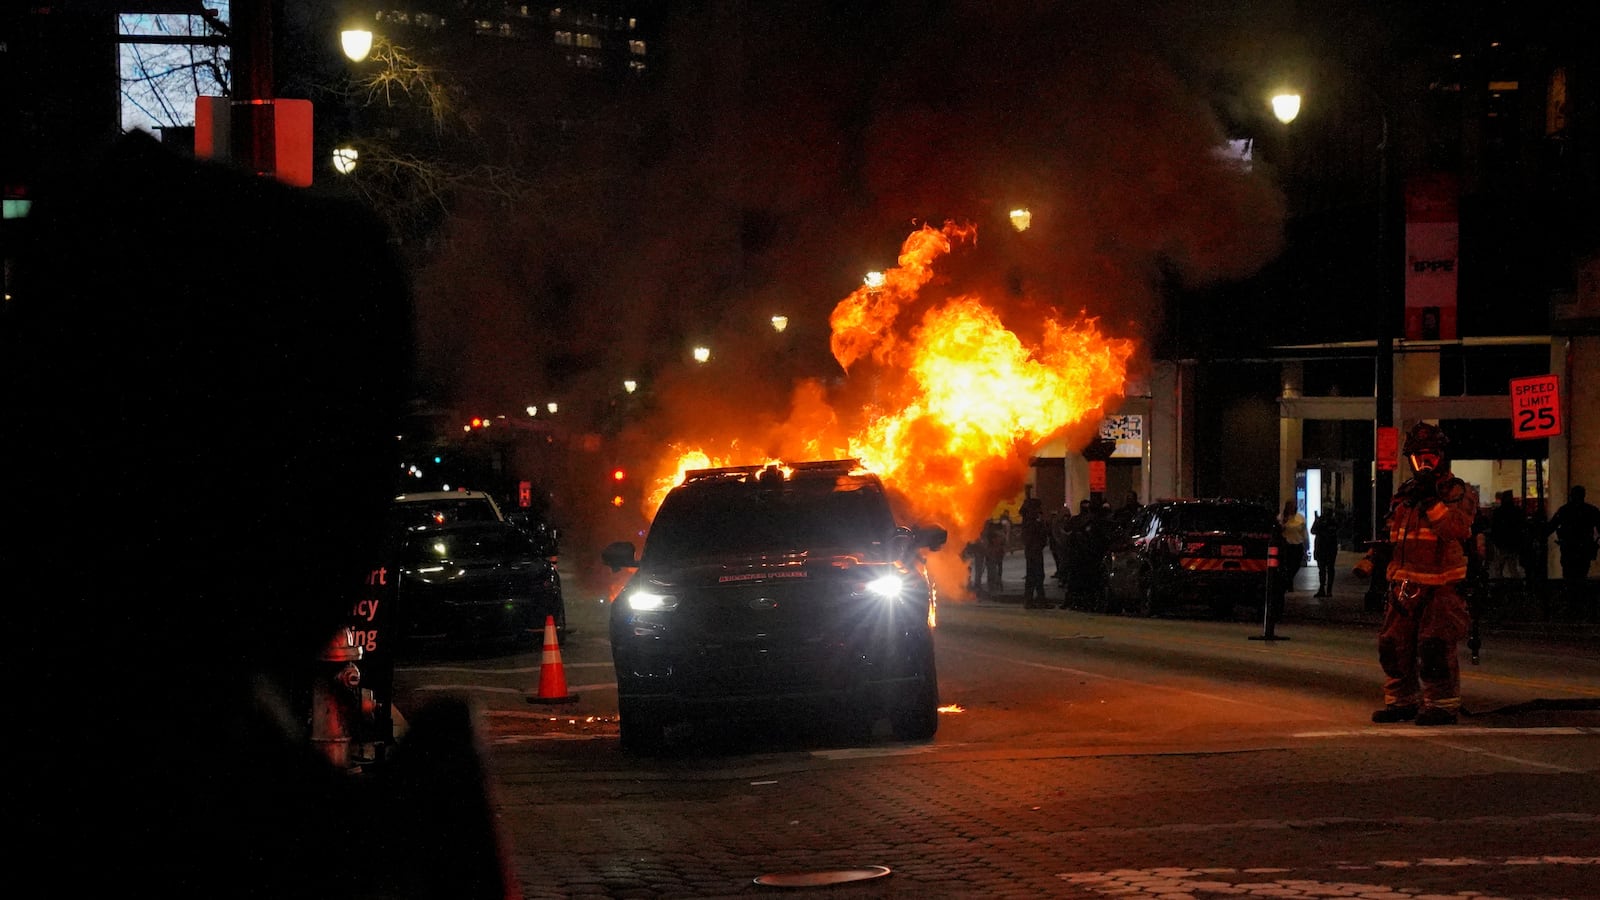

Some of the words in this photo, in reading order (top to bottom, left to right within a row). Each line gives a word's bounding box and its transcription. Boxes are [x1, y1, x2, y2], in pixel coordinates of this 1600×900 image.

[1515, 382, 1555, 396] SPEED
[1519, 395, 1551, 408] LIMIT
[1518, 407, 1556, 432] 25
